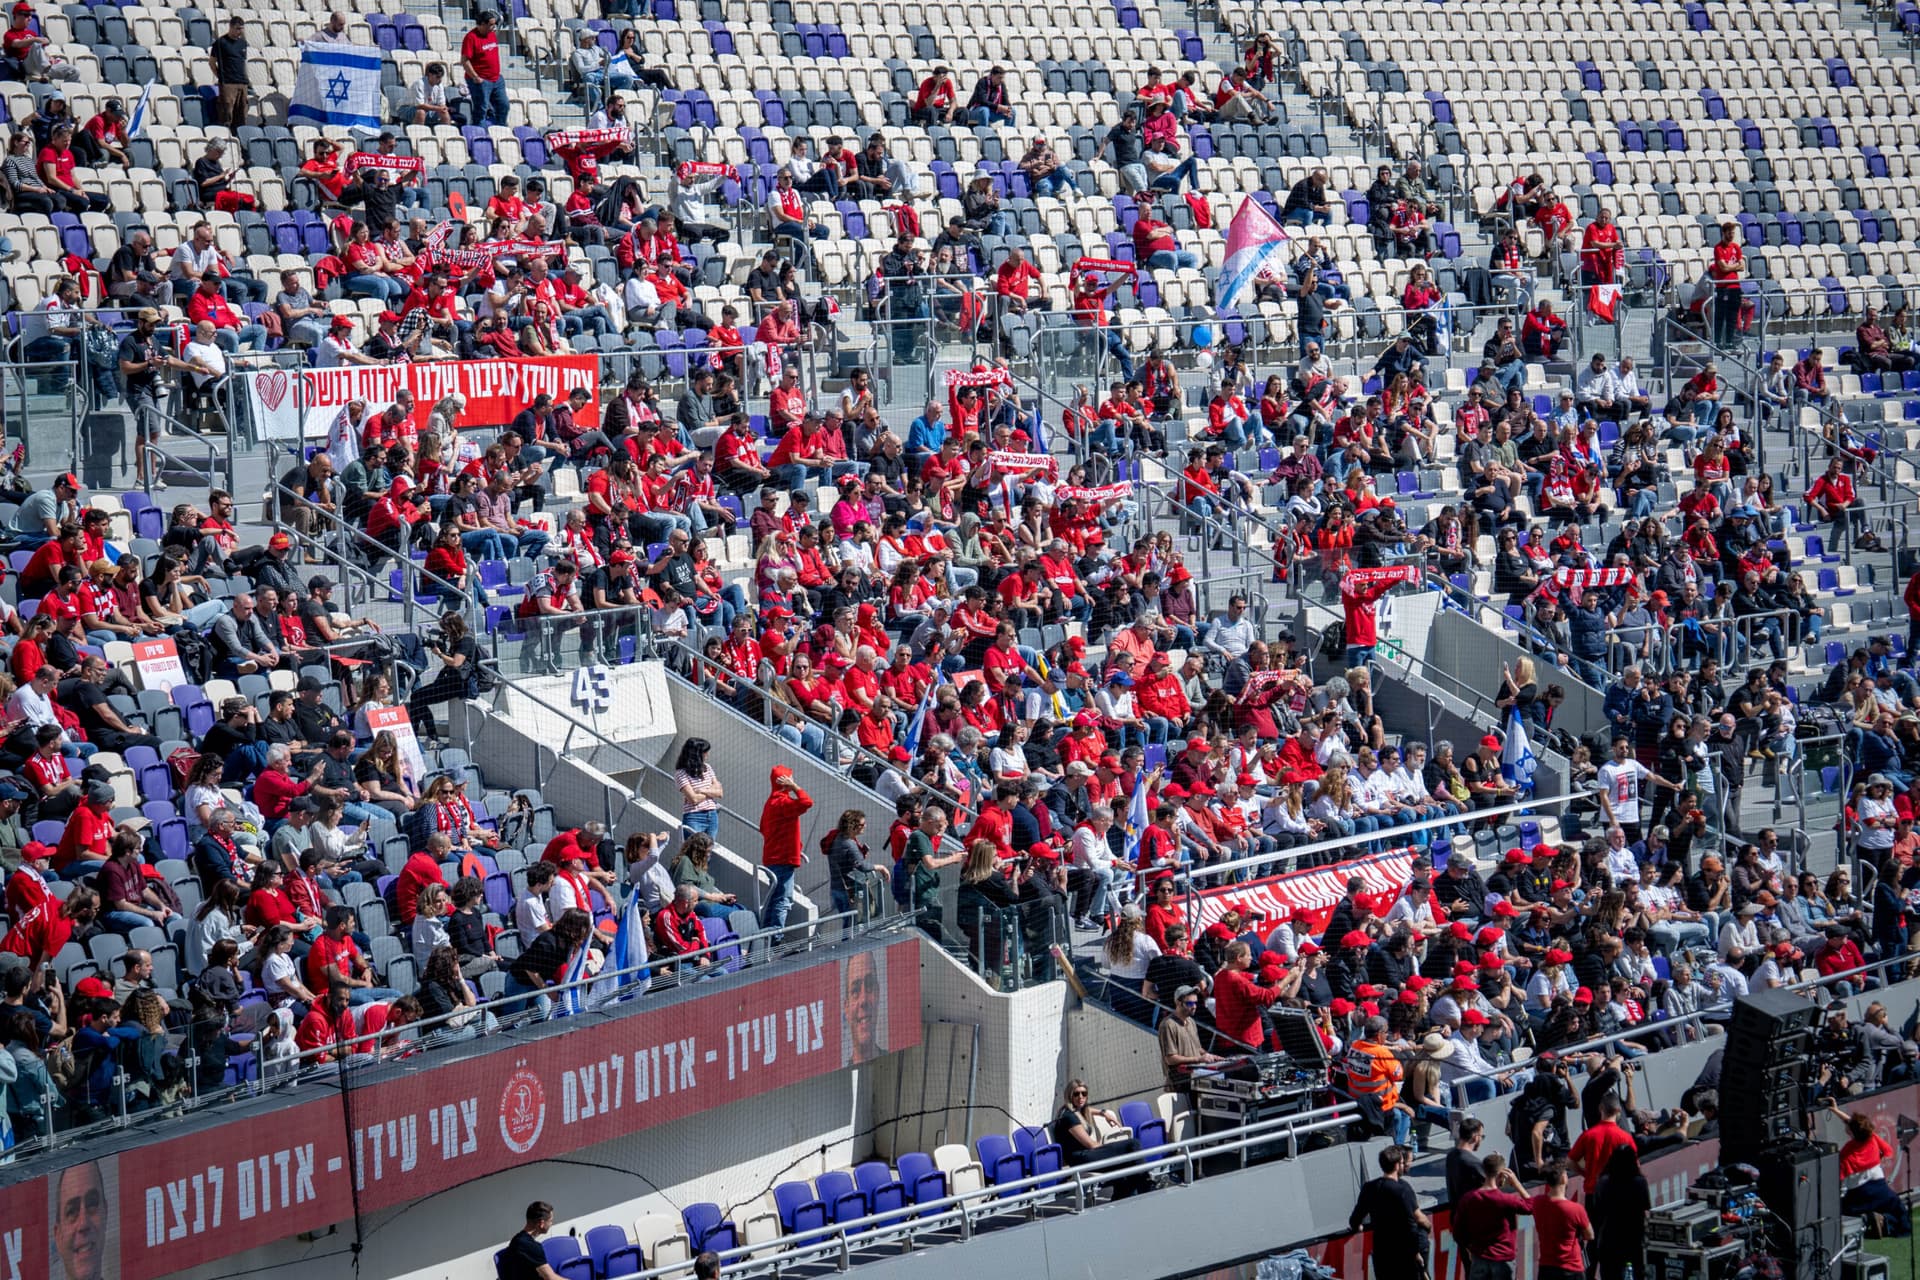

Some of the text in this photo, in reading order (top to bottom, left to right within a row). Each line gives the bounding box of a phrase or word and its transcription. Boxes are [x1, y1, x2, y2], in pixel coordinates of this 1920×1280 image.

[358, 367, 402, 406] אדום
[415, 363, 461, 401] שלנו
[521, 364, 558, 404] עידן
[571, 663, 613, 715] 43
[726, 1013, 777, 1081] עידן
[785, 1000, 825, 1055] צחי
[562, 1053, 625, 1125] לנצח
[634, 1037, 697, 1104] אדום
[353, 1113, 418, 1192] עידן
[429, 1097, 478, 1160] צחי
[145, 1165, 224, 1248] לנצח
[238, 1143, 316, 1222] אדום
